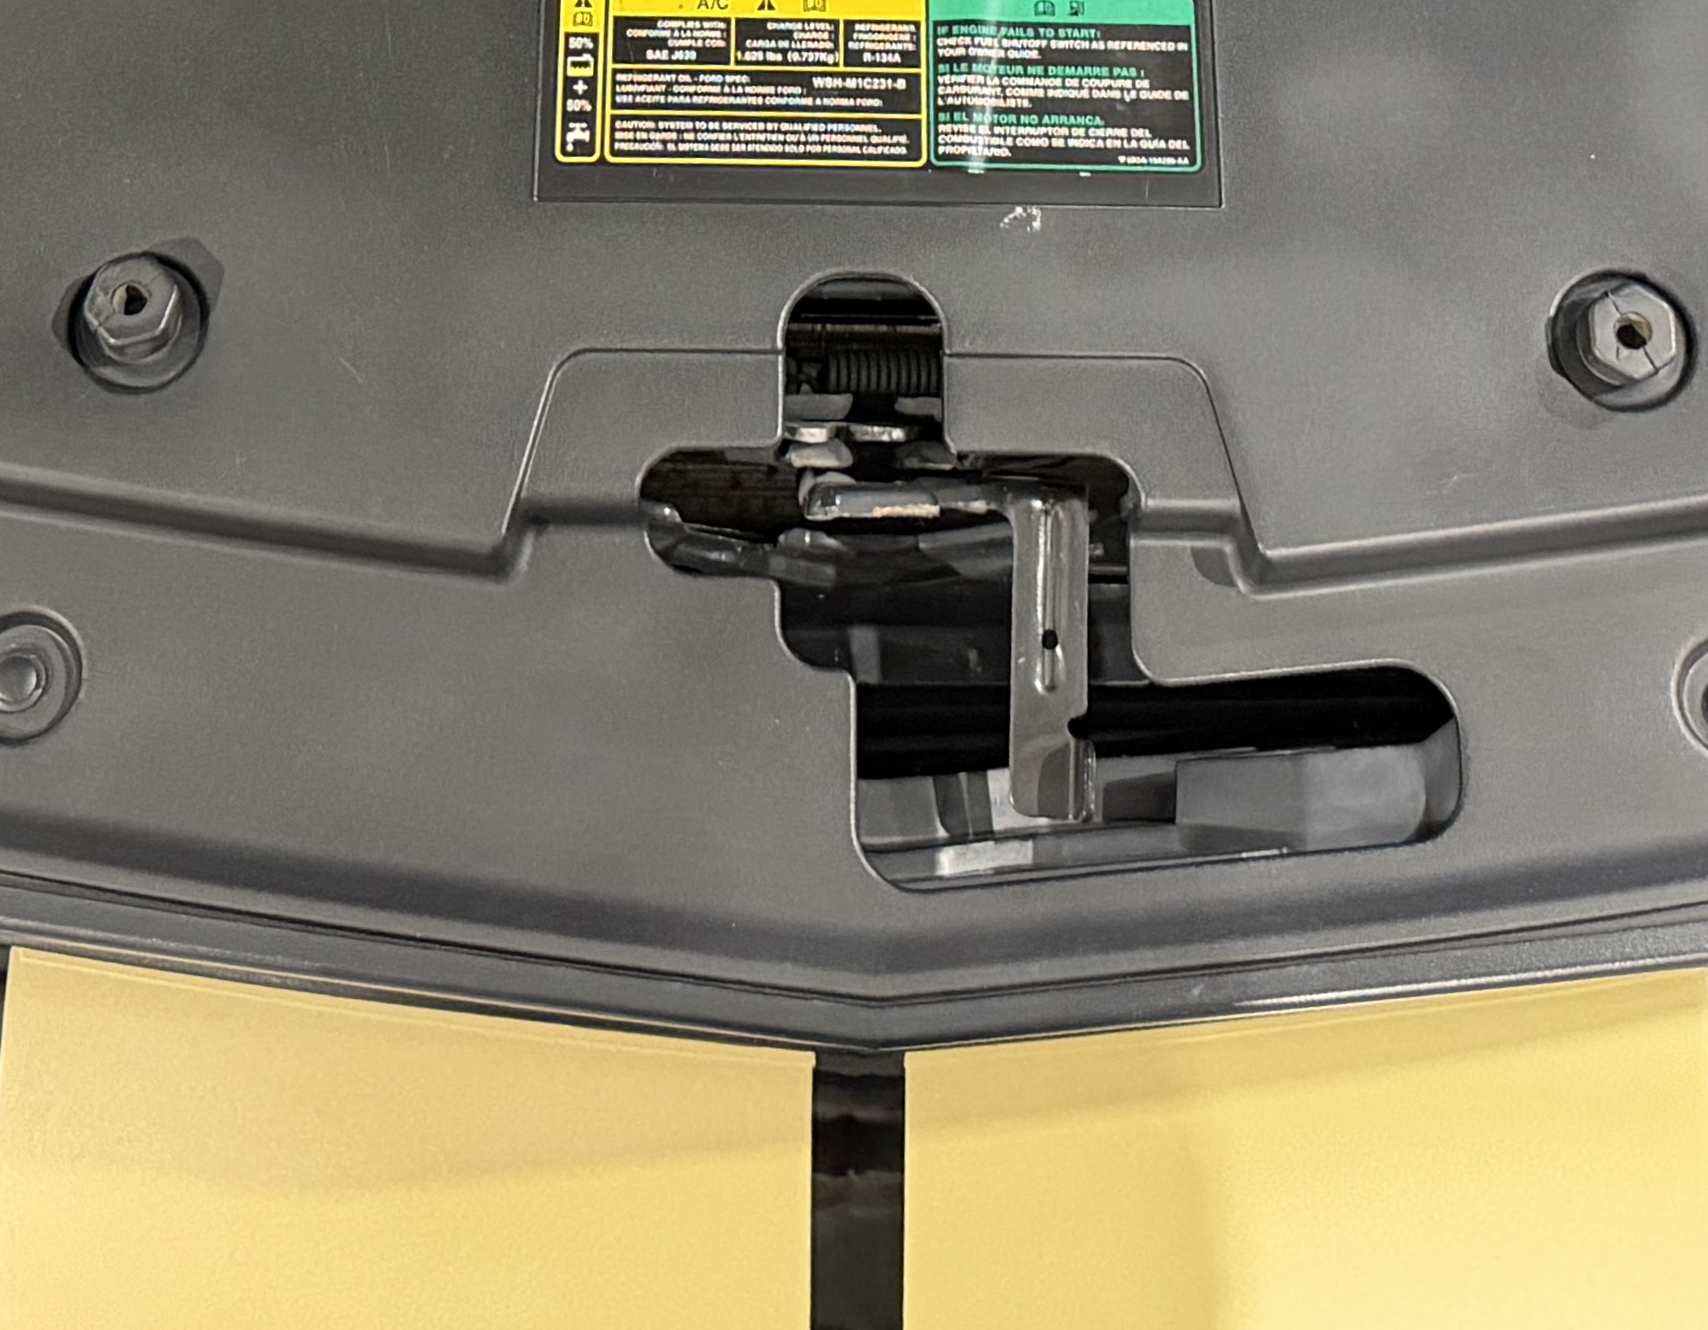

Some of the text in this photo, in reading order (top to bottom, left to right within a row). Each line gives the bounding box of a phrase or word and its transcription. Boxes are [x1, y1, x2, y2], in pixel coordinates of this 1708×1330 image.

[568, 36, 594, 50] 50%
[646, 51, 669, 60] SAE
[863, 52, 902, 63] R-134A
